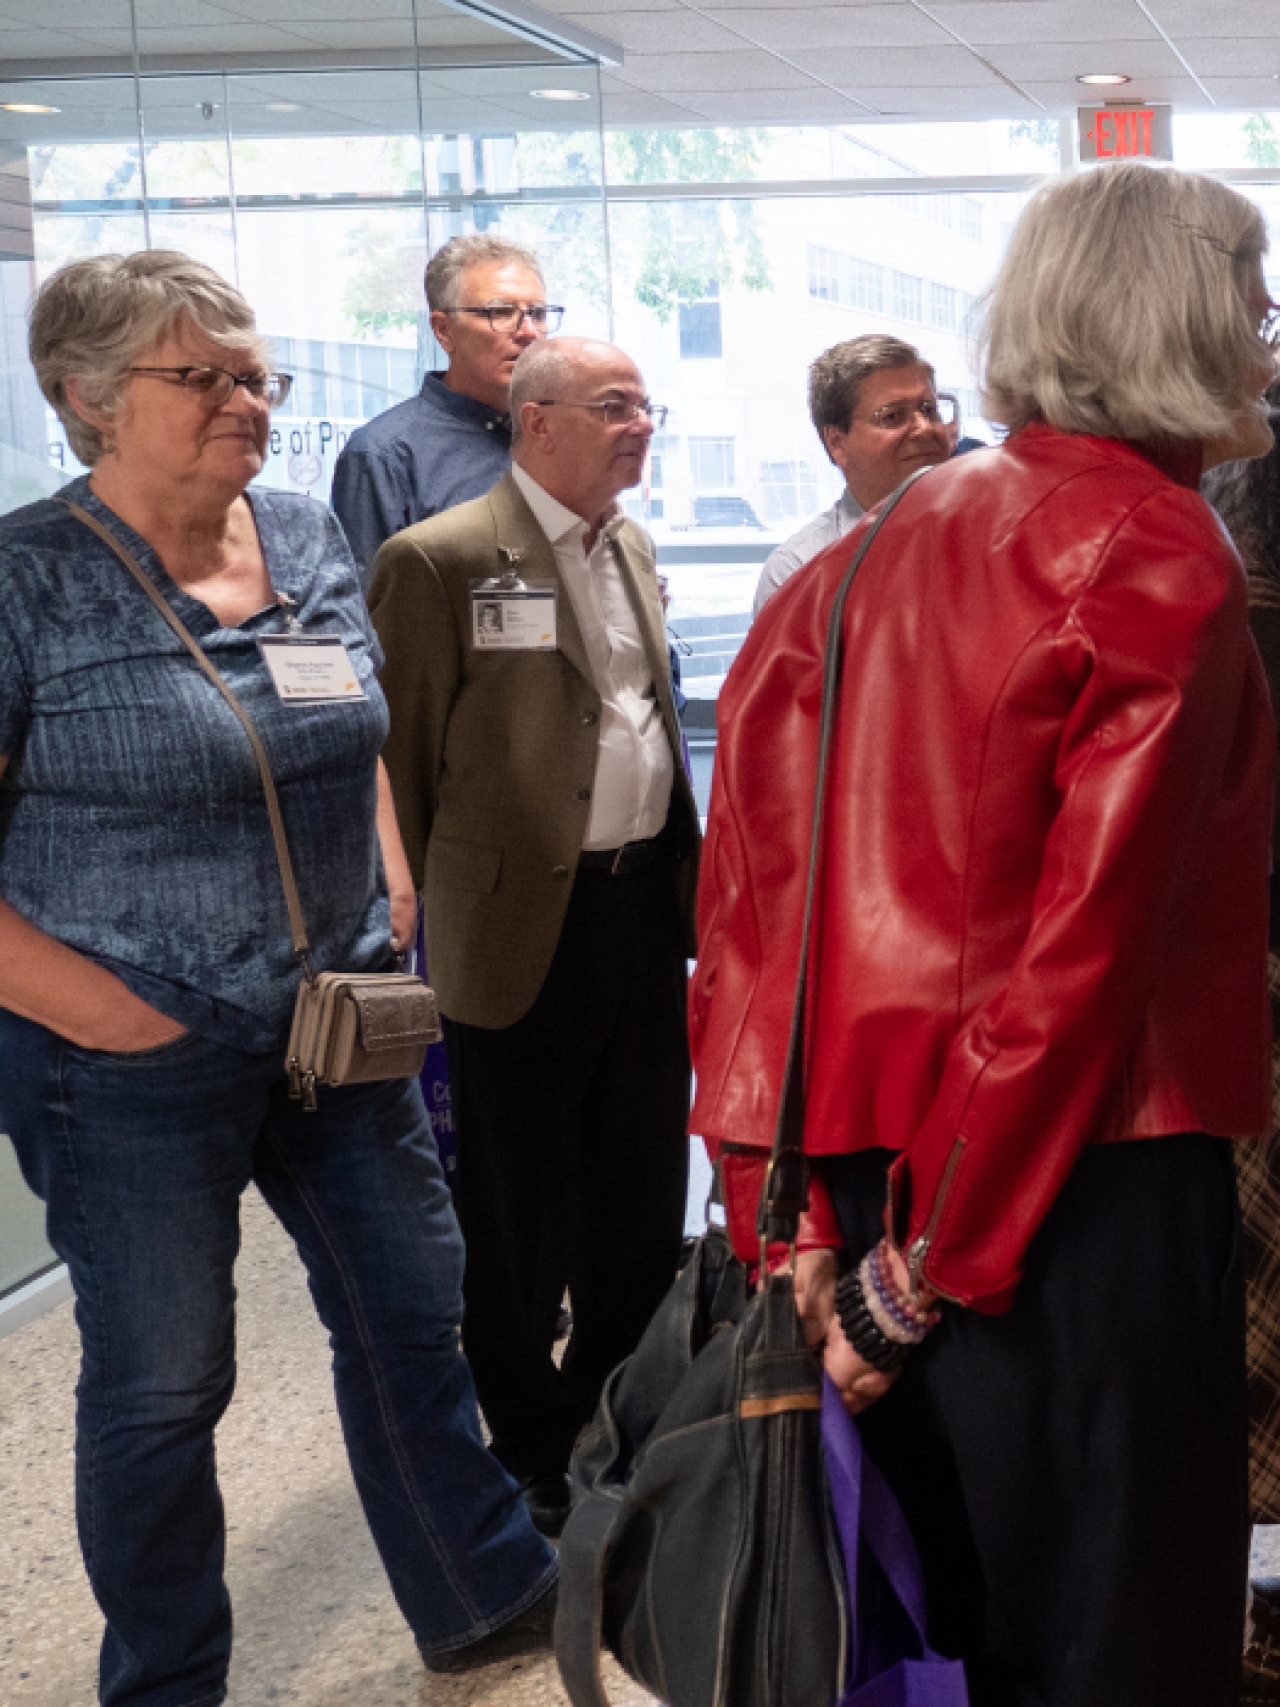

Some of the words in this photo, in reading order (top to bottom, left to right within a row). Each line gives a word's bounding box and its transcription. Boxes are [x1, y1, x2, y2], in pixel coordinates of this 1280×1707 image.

[1094, 110, 1155, 157] EXIT
[290, 421, 312, 455] of
[319, 421, 347, 455] Ph
[433, 1079, 452, 1102] Co
[429, 1108, 453, 1134] PH
